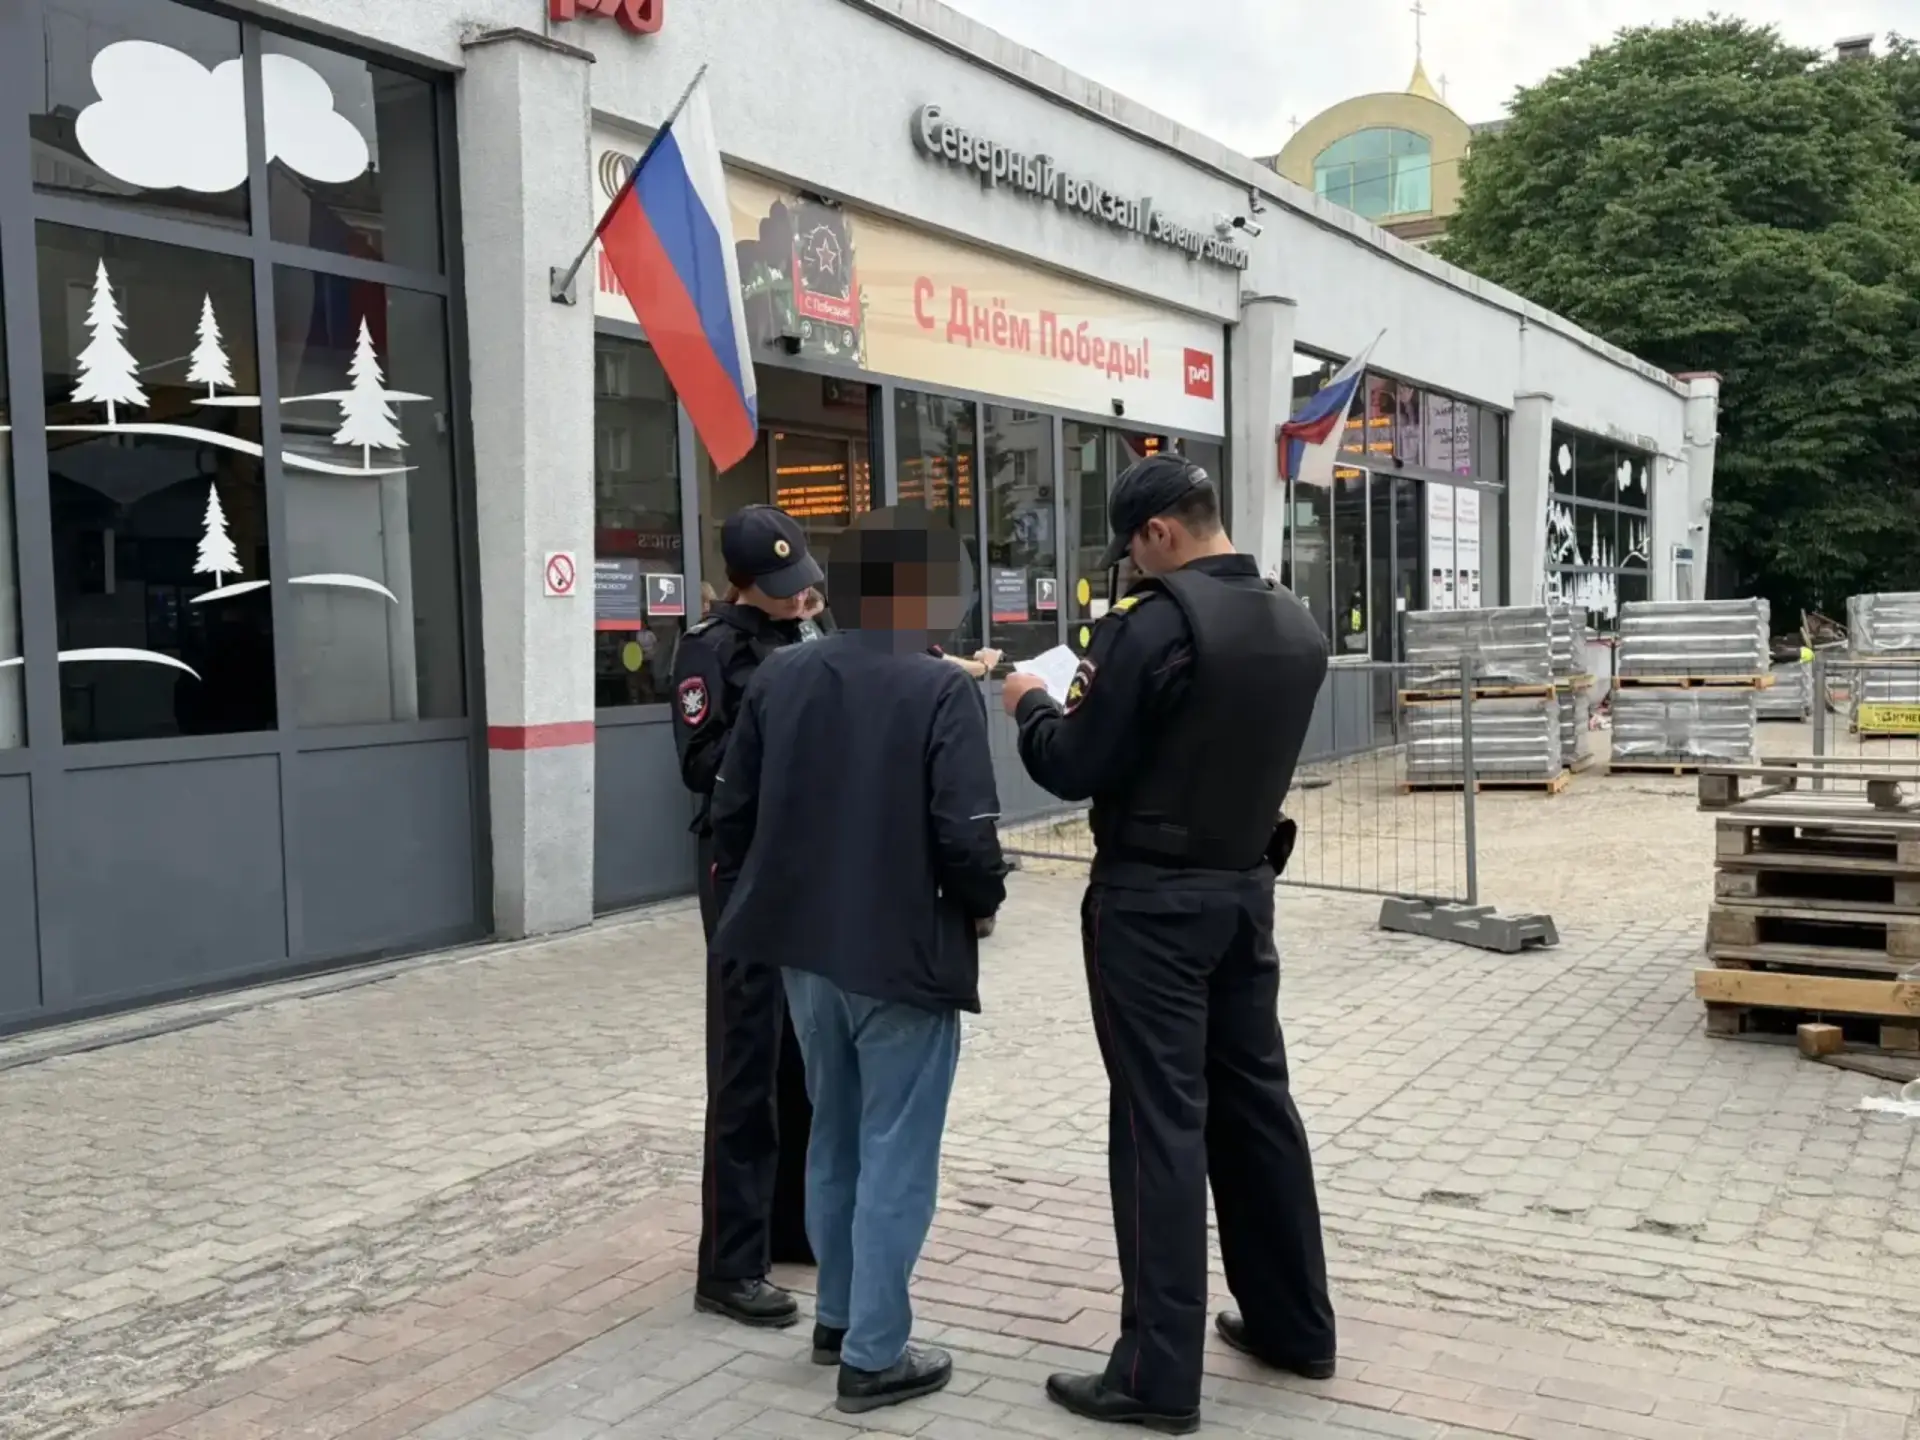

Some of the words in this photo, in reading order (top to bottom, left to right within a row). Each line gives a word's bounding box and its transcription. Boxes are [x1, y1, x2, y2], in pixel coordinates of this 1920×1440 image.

[912, 103, 1058, 199] Северный
[1060, 172, 1141, 232] вокзал
[1153, 212, 1206, 260] Severny
[913, 275, 935, 329] С
[946, 285, 1031, 351] Днём
[1039, 309, 1150, 382] Победы!
